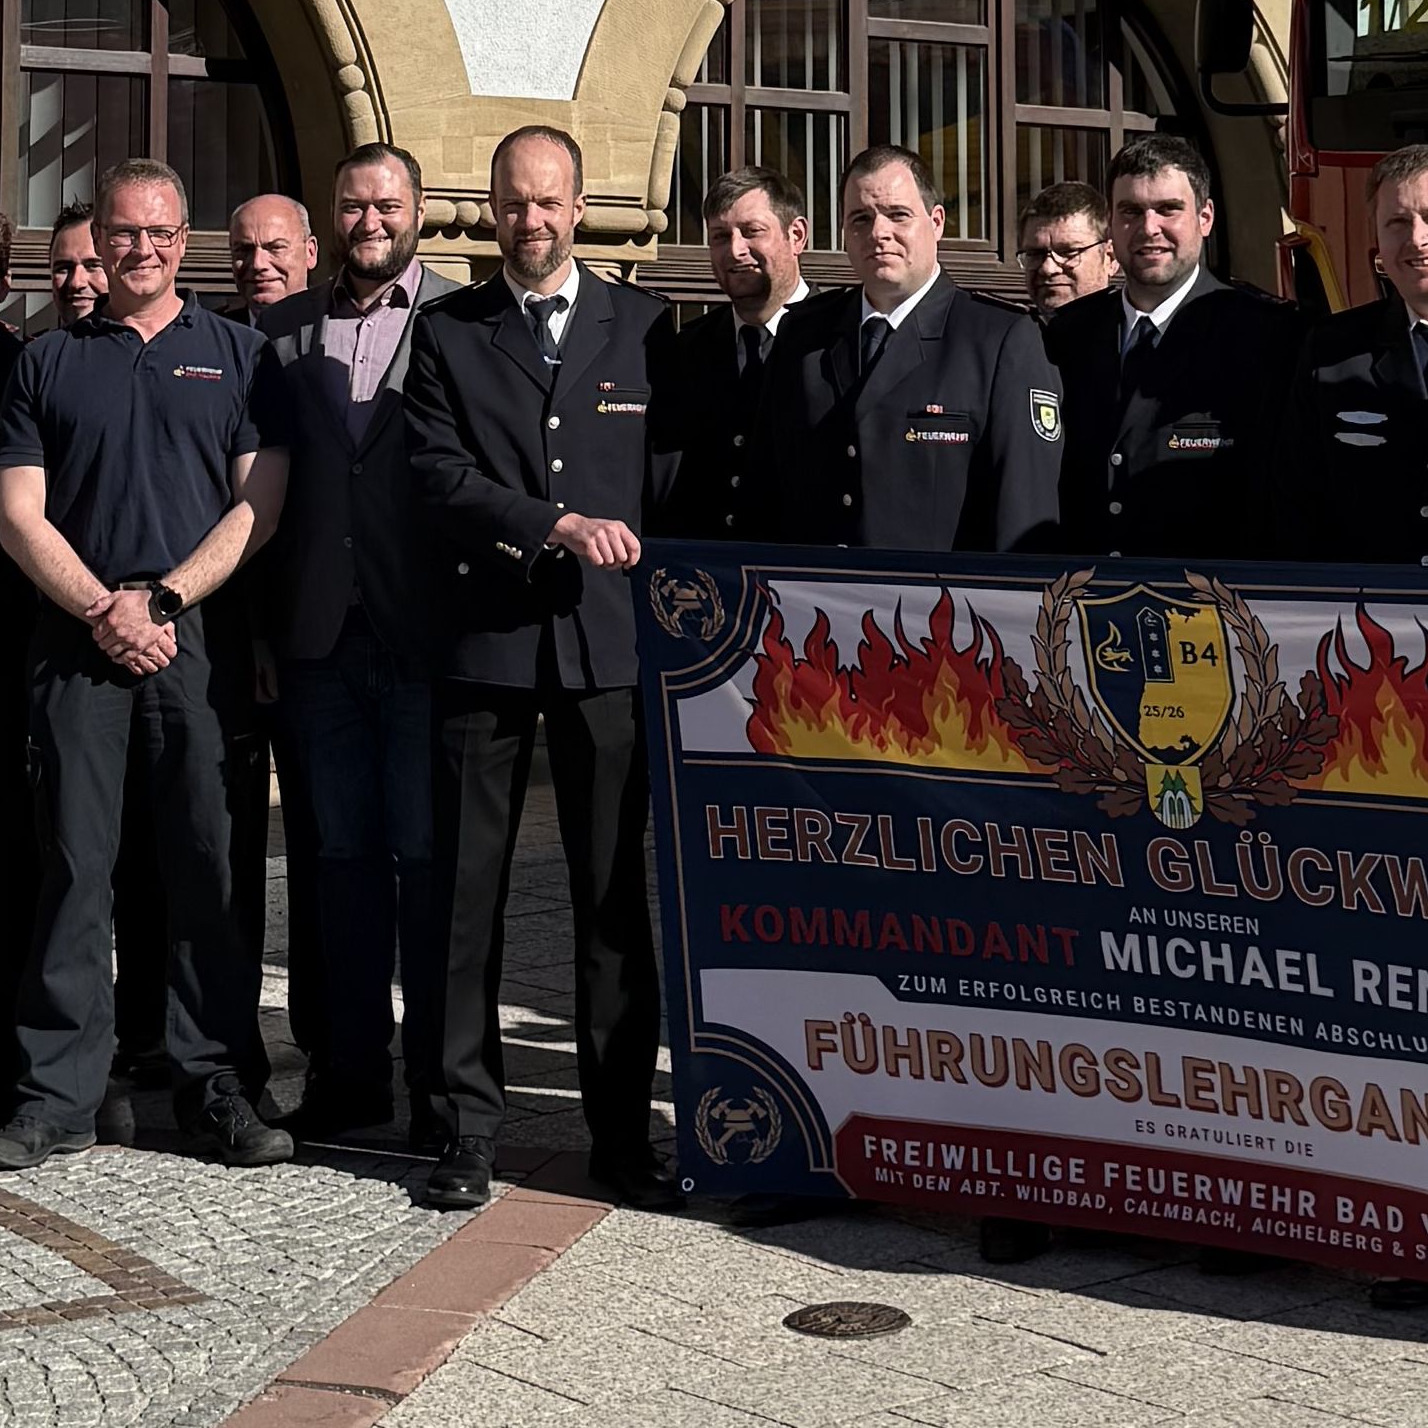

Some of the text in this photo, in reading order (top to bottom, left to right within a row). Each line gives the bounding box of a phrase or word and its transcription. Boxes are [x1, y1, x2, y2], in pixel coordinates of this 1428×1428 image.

[1179, 641, 1218, 667] B4
[1143, 705, 1185, 719] 25/26
[705, 804, 1125, 888] HERZLICHEN
[720, 904, 1080, 967] KOMMANDANT
[1100, 930, 1335, 998] MICHAEL
[1128, 906, 1261, 937] AN UNSEREN
[898, 974, 948, 995] ZUM
[959, 978, 1122, 1012] ERFOLGREICH
[1134, 995, 1305, 1037] BESTANDENEN
[1135, 1119, 1315, 1158] ES GRATULIERT DIE
[863, 1134, 1086, 1185] FREIWILLIGE
[1103, 1162, 1317, 1218] FEUERWEHR
[1336, 1195, 1405, 1234] BAD
[875, 1167, 907, 1186] MIT
[913, 1172, 951, 1193] DEN
[960, 1177, 1006, 1198] ABT.
[1015, 1184, 1113, 1215] WILDBAD,
[1123, 1197, 1242, 1233] CALMBACH,
[1251, 1215, 1383, 1254] AICHELBERG
[1391, 1241, 1405, 1258] &
